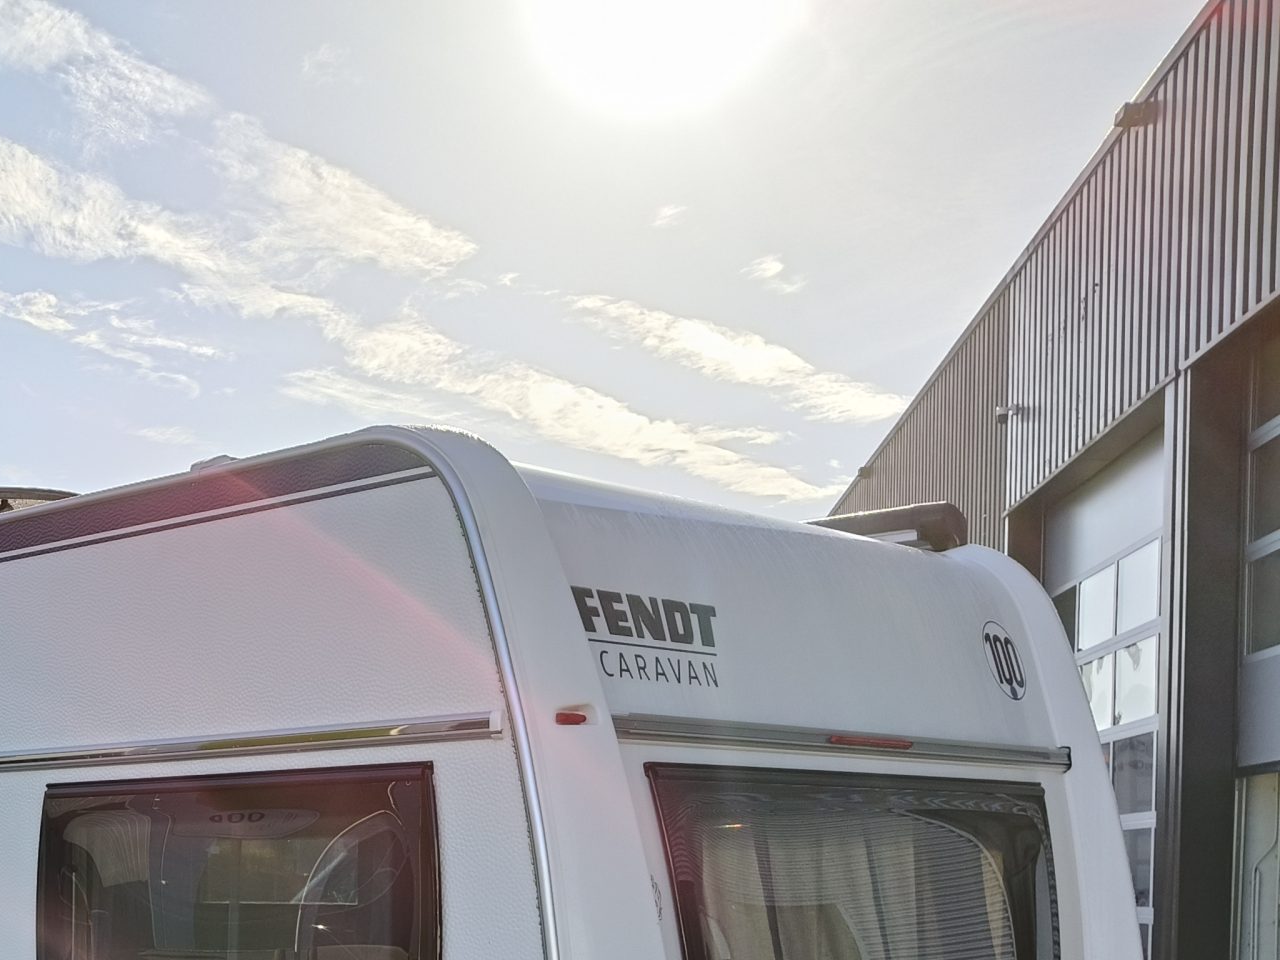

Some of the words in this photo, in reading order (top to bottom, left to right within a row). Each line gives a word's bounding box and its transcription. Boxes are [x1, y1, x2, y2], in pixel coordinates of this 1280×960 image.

[570, 585, 717, 648] FENDT
[599, 650, 719, 688] CARAVAN
[984, 632, 1024, 688] 100
